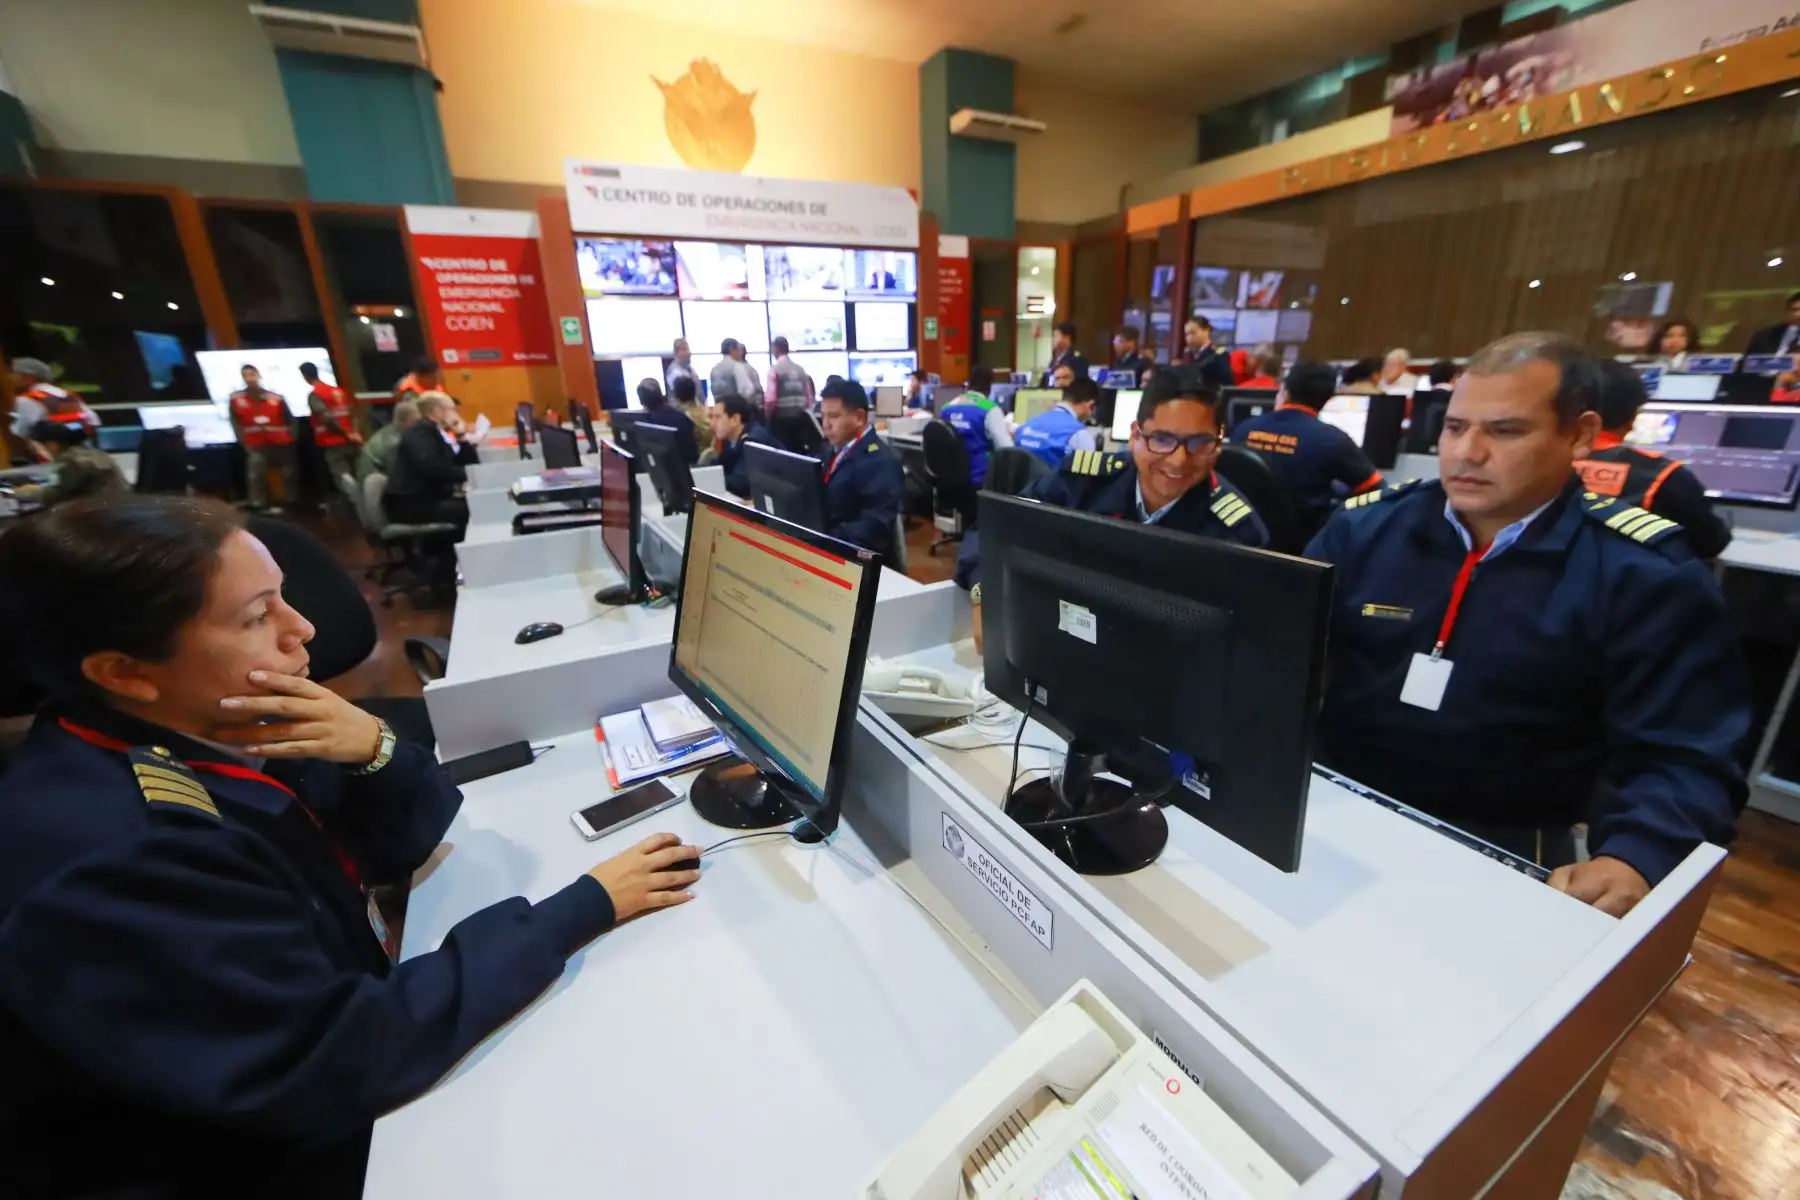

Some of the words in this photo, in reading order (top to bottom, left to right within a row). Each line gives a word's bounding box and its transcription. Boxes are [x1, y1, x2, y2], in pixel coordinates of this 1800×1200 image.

[602, 187, 671, 205] CENTRO
[676, 193, 697, 207] DE
[702, 195, 806, 215] OPERACIONES
[810, 203, 828, 216] DE
[967, 856, 1009, 902] SERVICIO
[978, 854, 1014, 895] OFICIAL
[1017, 889, 1031, 911] DE
[1155, 1037, 1200, 1085] MODULO
